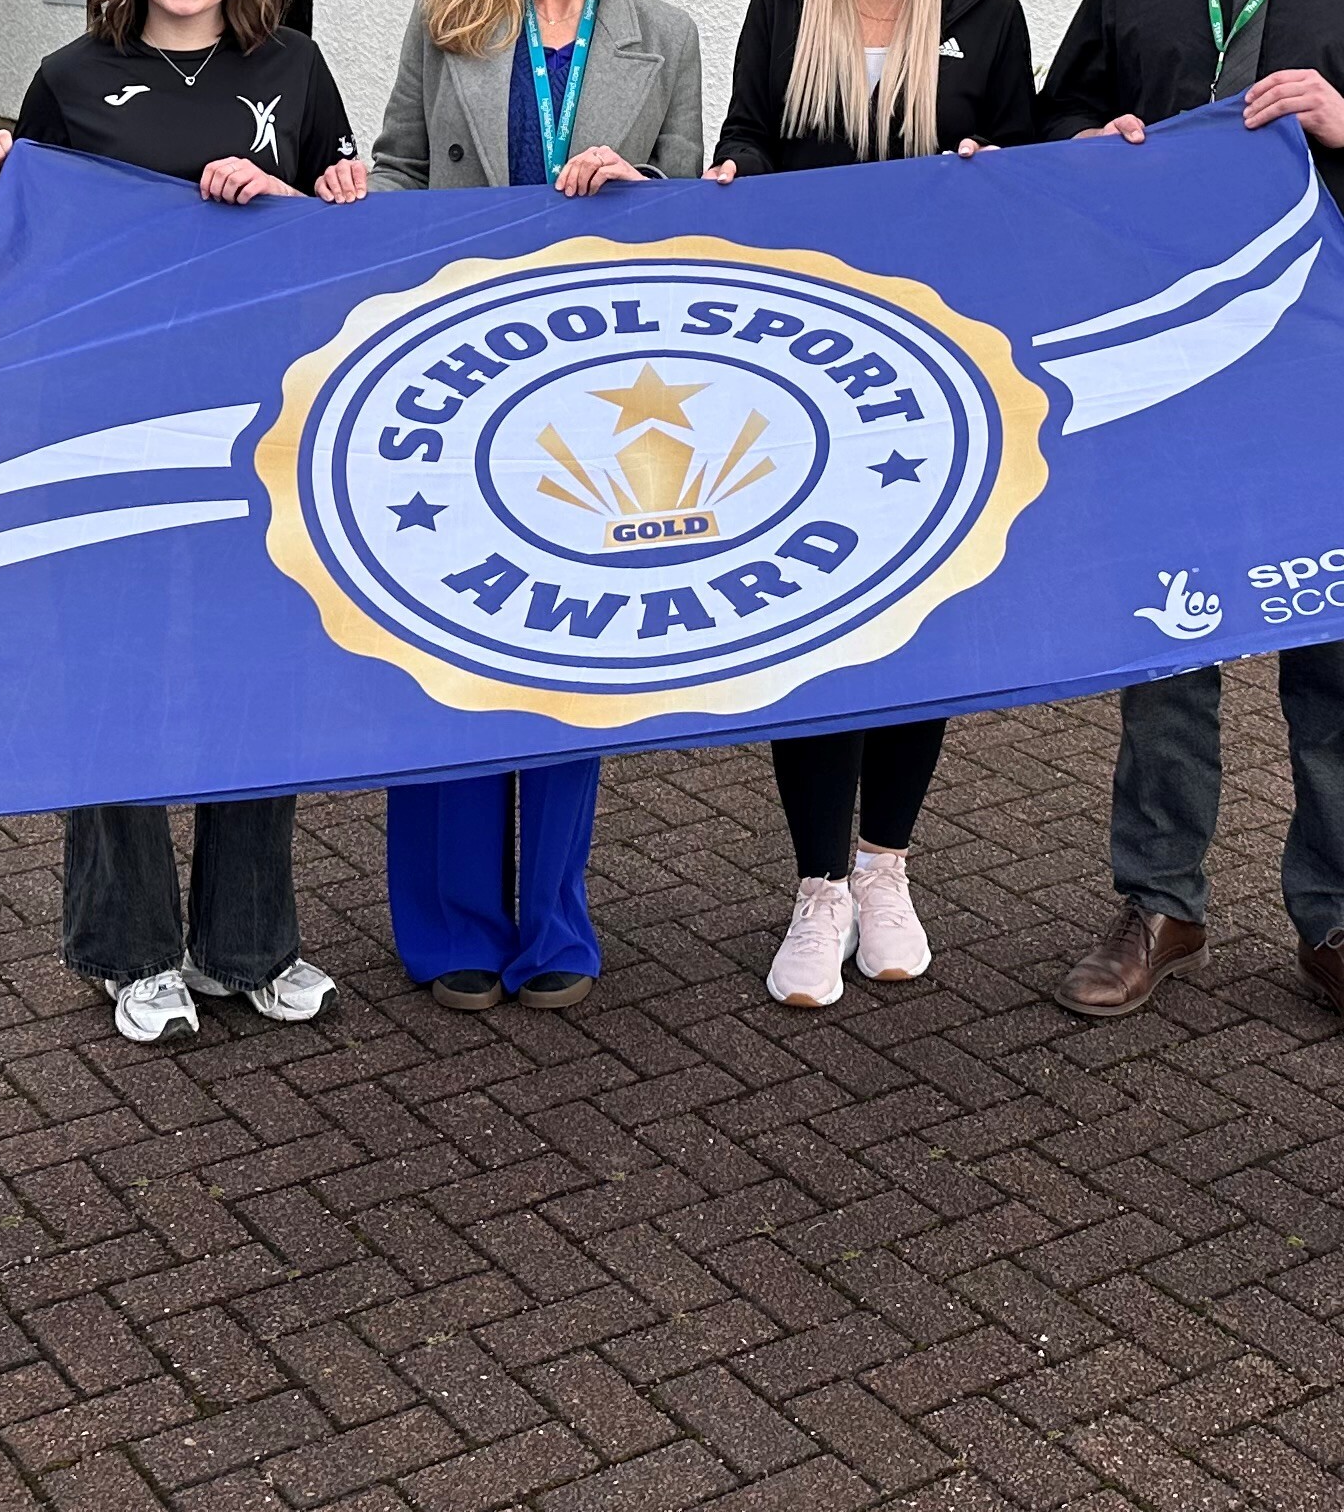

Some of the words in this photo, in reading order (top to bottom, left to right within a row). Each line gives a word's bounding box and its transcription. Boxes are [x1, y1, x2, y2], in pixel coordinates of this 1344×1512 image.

[1244, 1, 1258, 14] The
[378, 300, 659, 464] SCHOOL
[681, 302, 926, 424] SPORT
[612, 515, 710, 543] GOLD
[443, 520, 858, 639] AWARD
